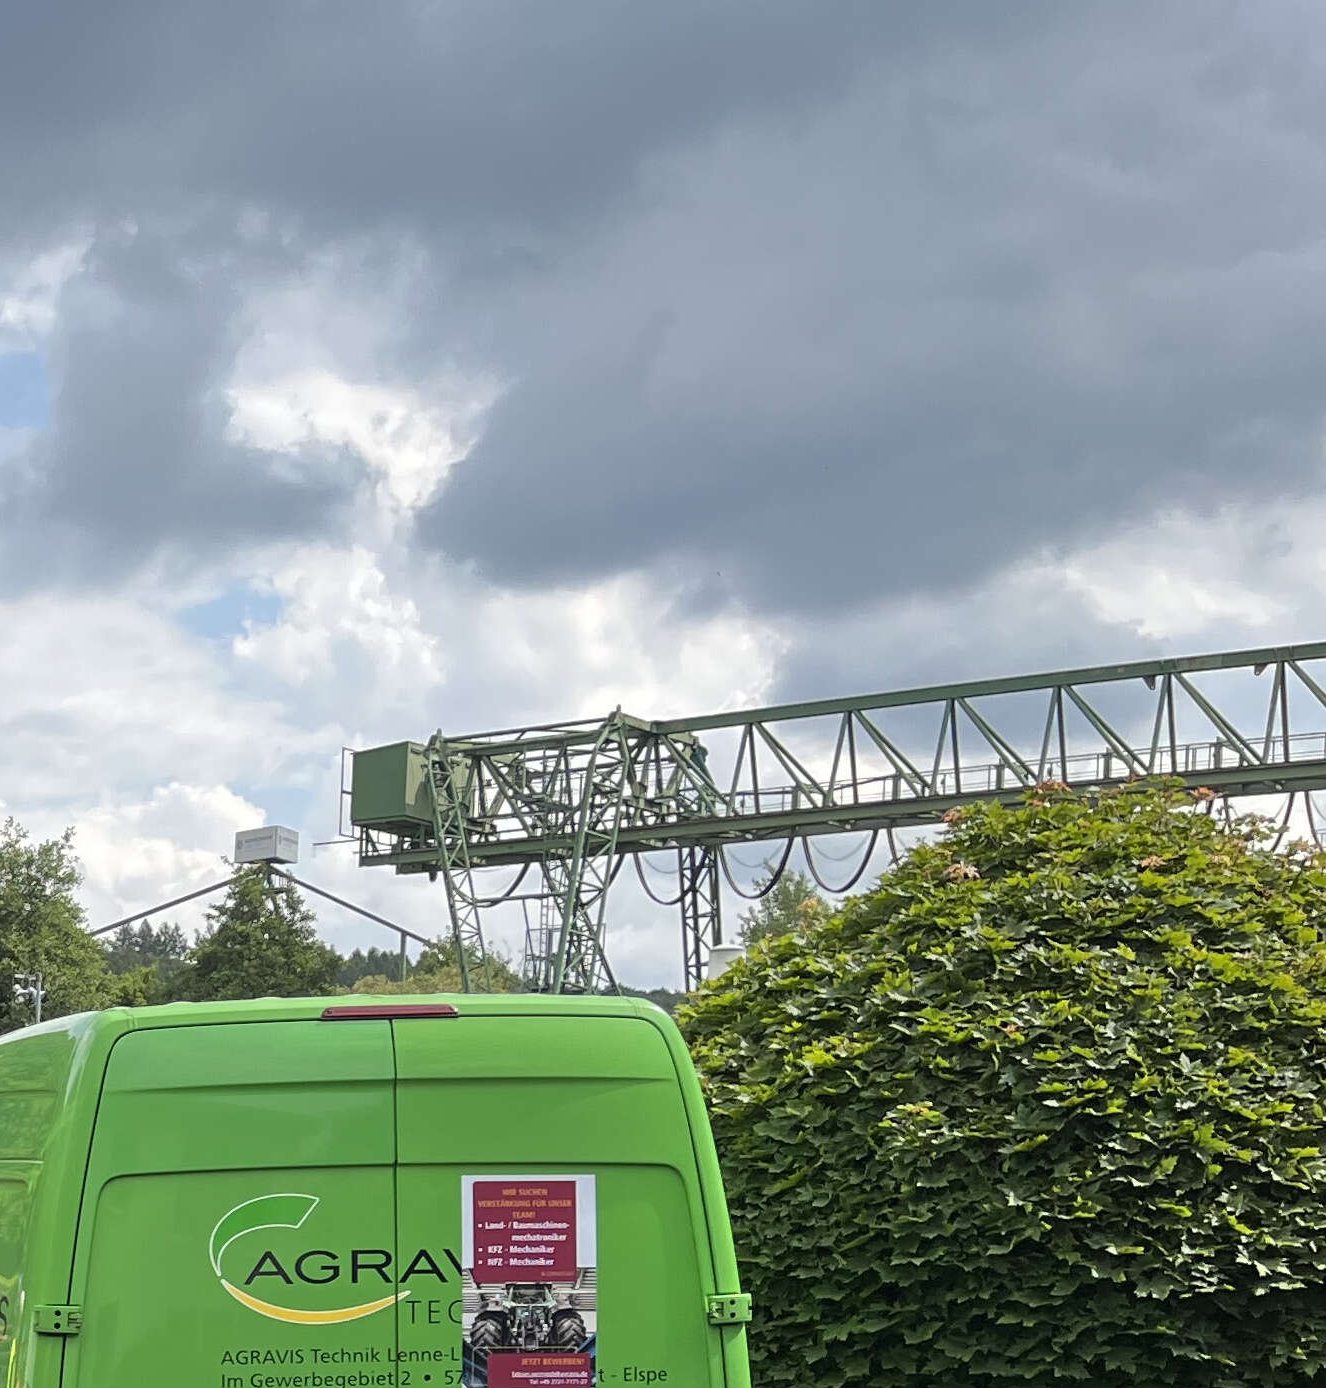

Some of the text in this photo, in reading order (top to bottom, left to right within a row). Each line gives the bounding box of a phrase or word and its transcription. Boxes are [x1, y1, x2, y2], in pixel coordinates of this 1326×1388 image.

[221, 1347, 460, 1365] AGRAVIS Technik Lenne-L
[221, 1374, 244, 1388] Im
[400, 1370, 411, 1386] 2
[623, 1366, 668, 1386] Elspe
